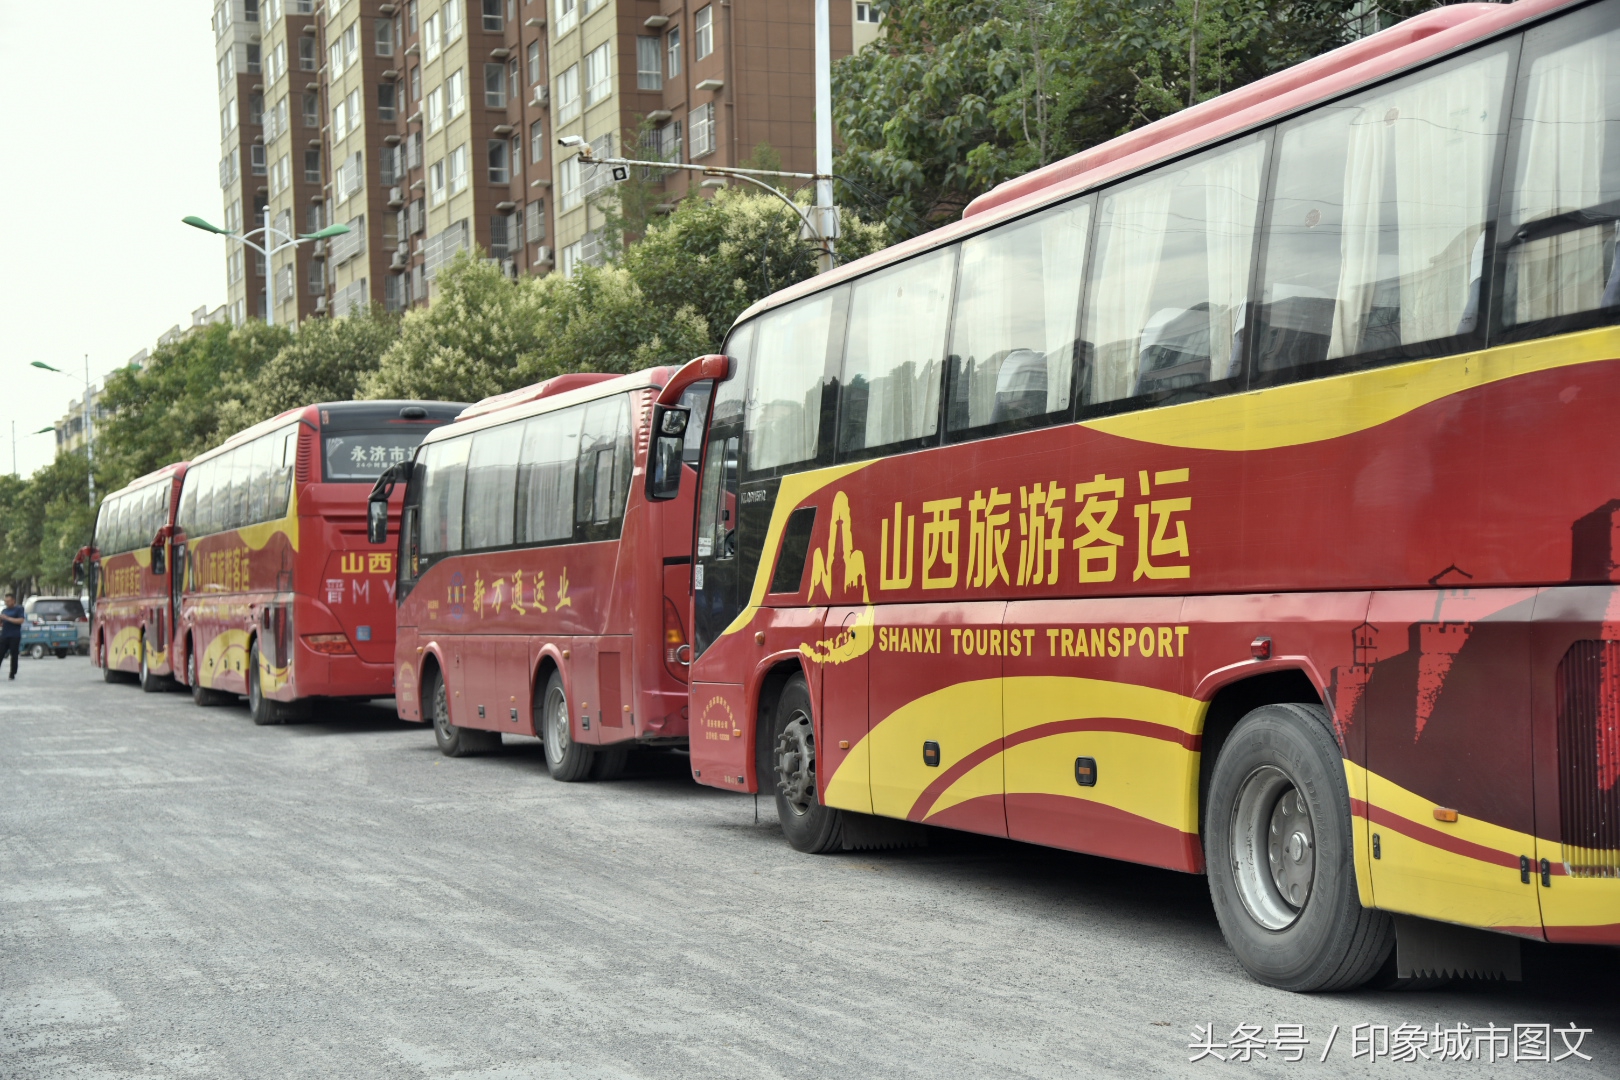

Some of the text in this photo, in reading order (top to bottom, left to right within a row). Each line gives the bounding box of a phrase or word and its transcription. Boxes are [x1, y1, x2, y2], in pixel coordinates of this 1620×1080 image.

[880, 467, 1192, 590] 山西旅游客运
[341, 552, 397, 574] 山西
[473, 566, 572, 619] 新万通运业
[878, 626, 1189, 657] SHANXI TOURIST TRANSPORT
